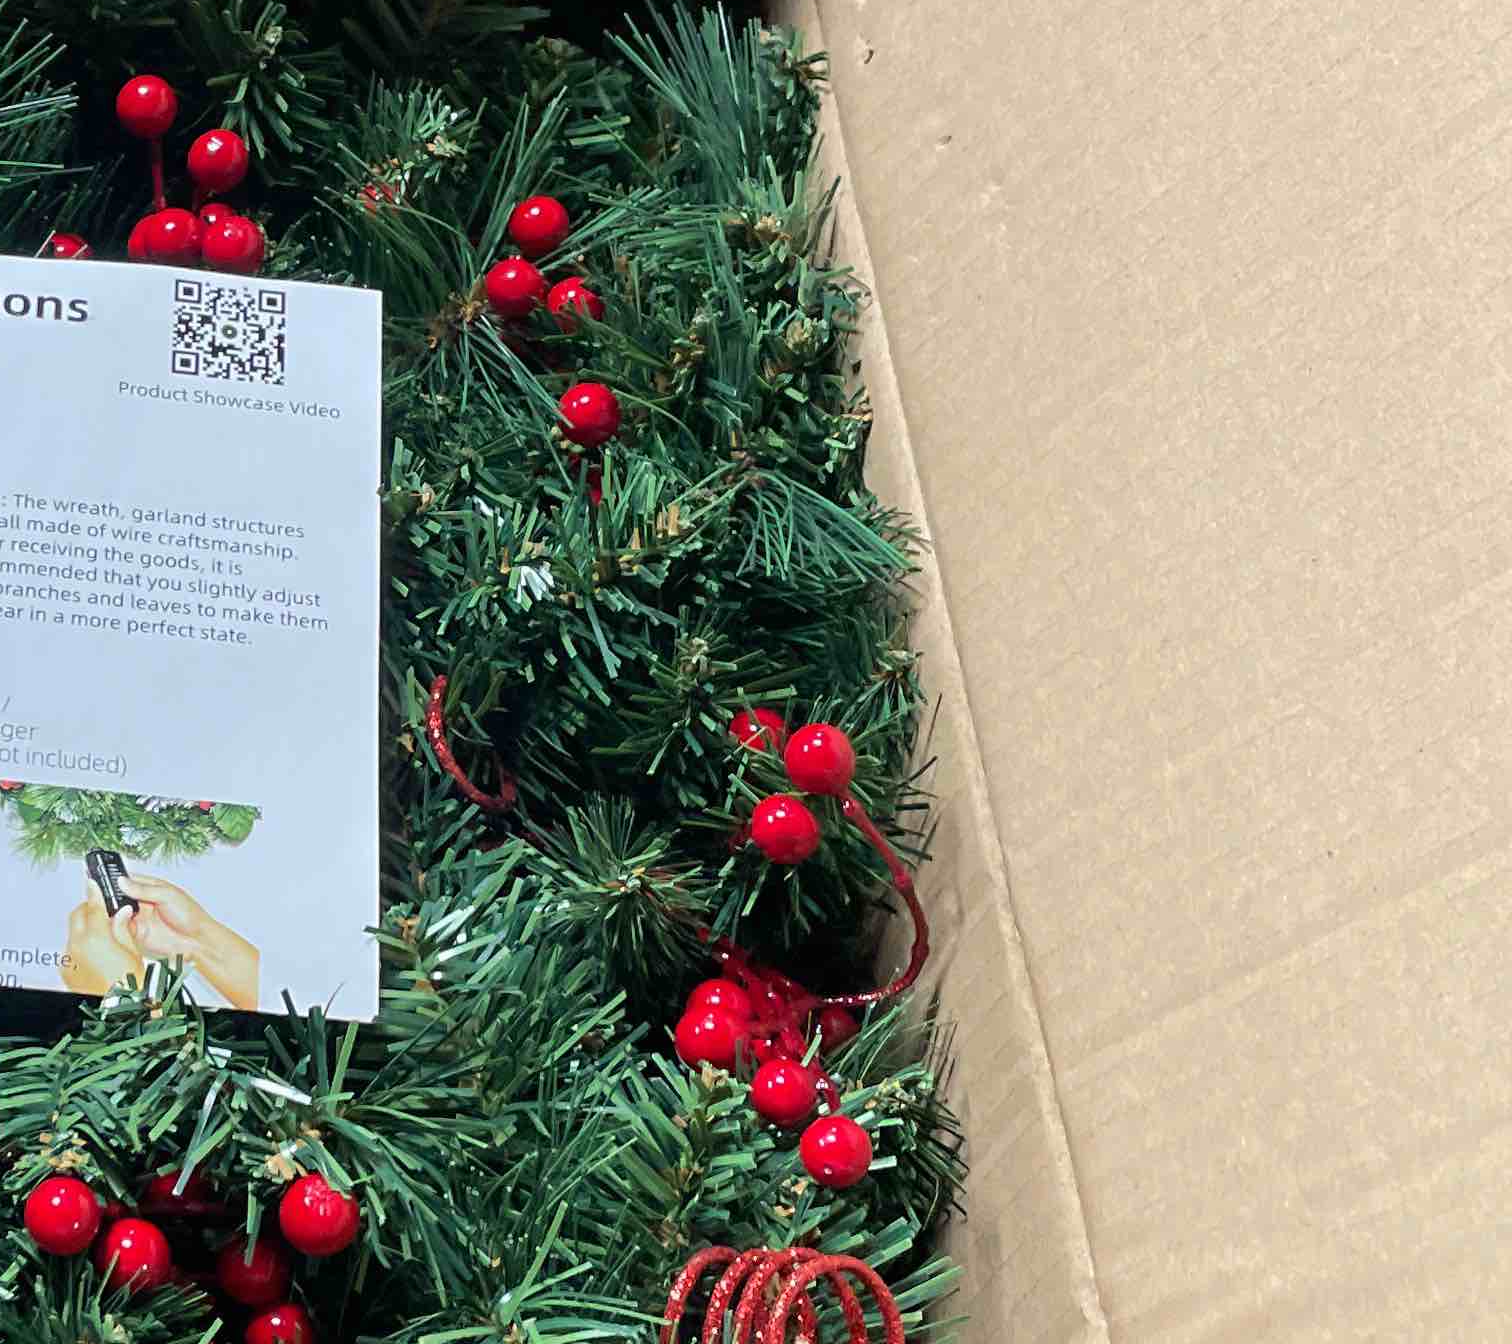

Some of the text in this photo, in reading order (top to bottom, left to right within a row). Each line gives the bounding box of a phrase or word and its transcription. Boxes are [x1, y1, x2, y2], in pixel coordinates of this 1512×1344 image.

[118, 380, 341, 419] Product Showcase Video
[13, 494, 47, 510] The
[54, 498, 125, 519] wreath,
[132, 509, 206, 528] garland
[212, 515, 304, 538] structures
[11, 538, 98, 562] receiving
[105, 546, 134, 563] the
[140, 552, 205, 574] goods,
[212, 560, 224, 575] it
[229, 560, 243, 576] is
[26, 517, 81, 535] made
[88, 523, 107, 538] of
[112, 528, 153, 543] wire
[158, 533, 299, 561] craftsmanship.
[104, 568, 141, 586] that
[147, 576, 182, 592] you
[188, 579, 256, 601] slightly
[262, 587, 321, 608] adjust
[30, 607, 47, 622] in
[54, 612, 64, 624] a
[71, 614, 121, 630] more
[127, 619, 194, 638] perfect
[200, 627, 253, 645] state.
[87, 591, 124, 608] and
[130, 593, 191, 614] leaves
[197, 602, 216, 618] to
[222, 604, 274, 625] make
[280, 612, 329, 631] them
[26, 748, 127, 777] included)
